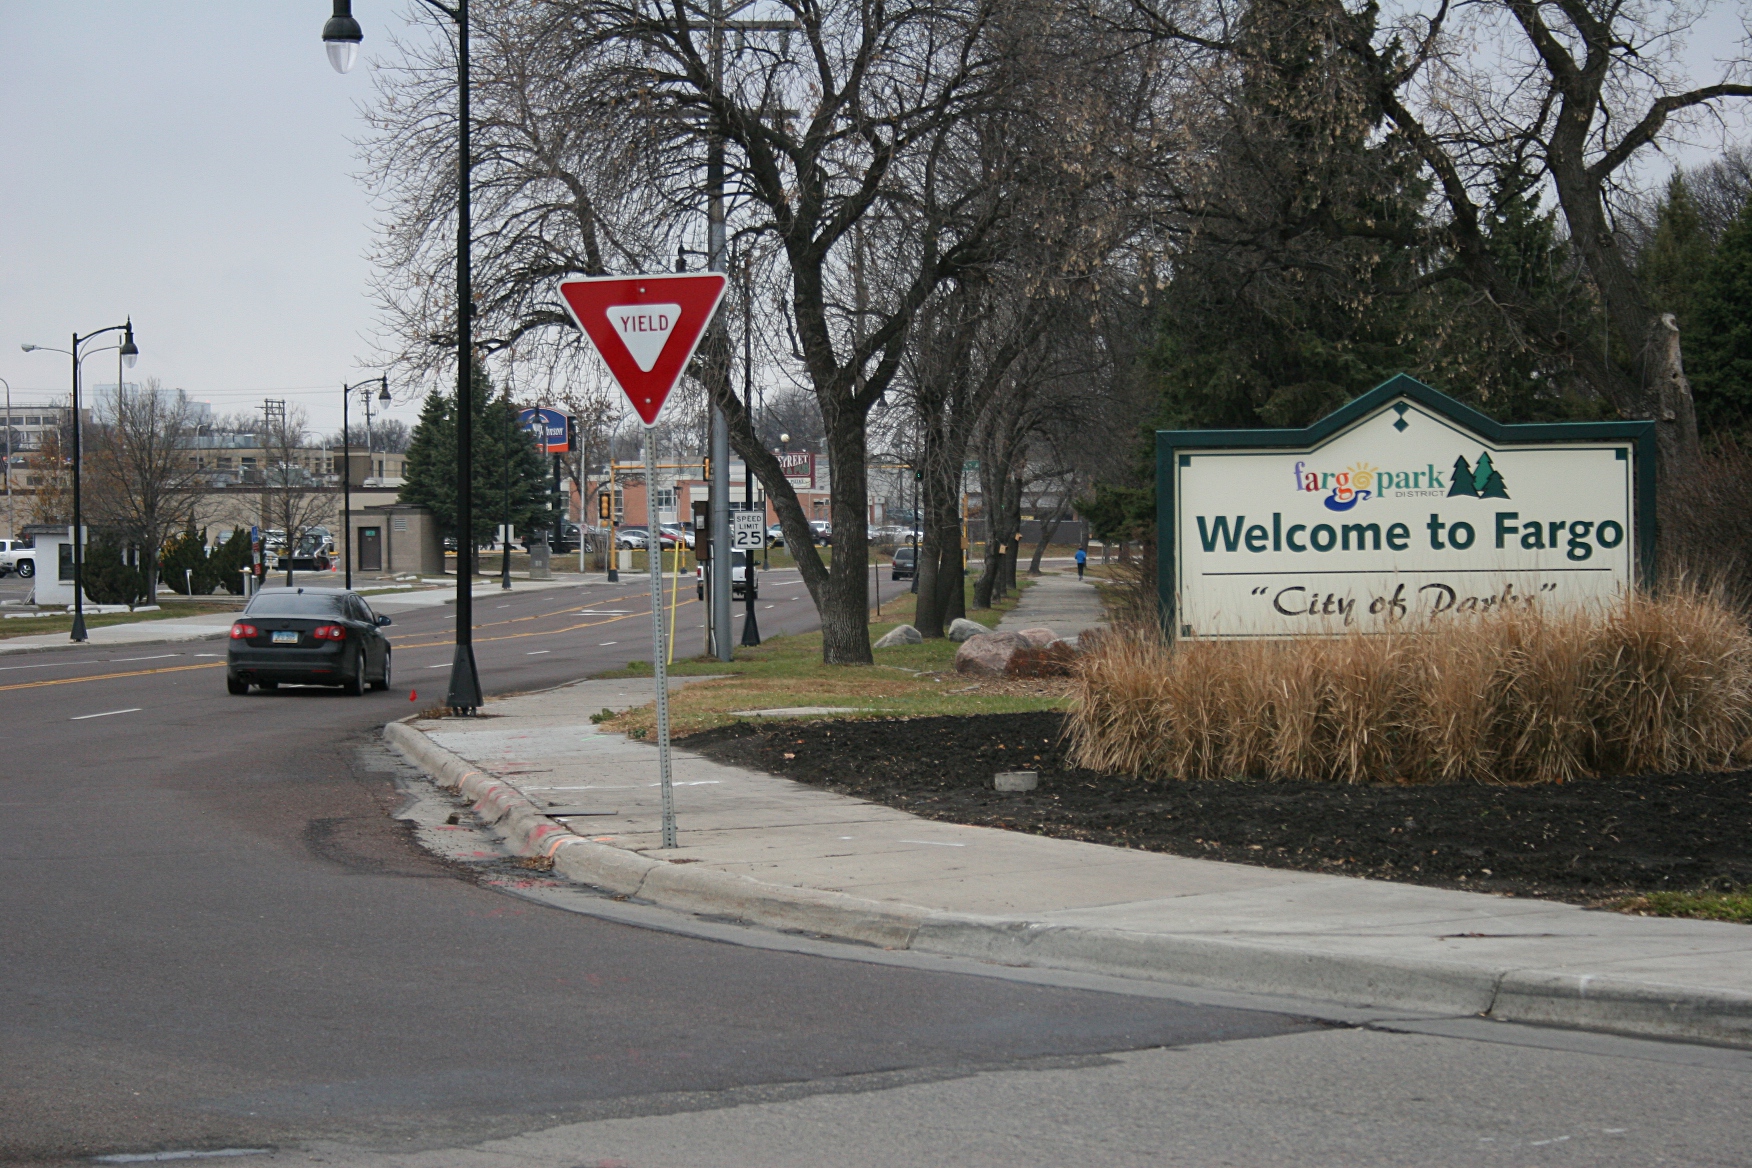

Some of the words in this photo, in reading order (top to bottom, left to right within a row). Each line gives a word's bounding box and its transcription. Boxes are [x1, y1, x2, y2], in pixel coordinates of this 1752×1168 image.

[620, 314, 669, 333] YIELD
[1375, 464, 1446, 498] park
[1395, 490, 1446, 498] DISTRICT
[737, 531, 762, 545] 25
[1196, 512, 1411, 553] Welcome
[1426, 513, 1476, 550] to
[1495, 511, 1624, 562] Fargo
[1369, 583, 1407, 624] of
